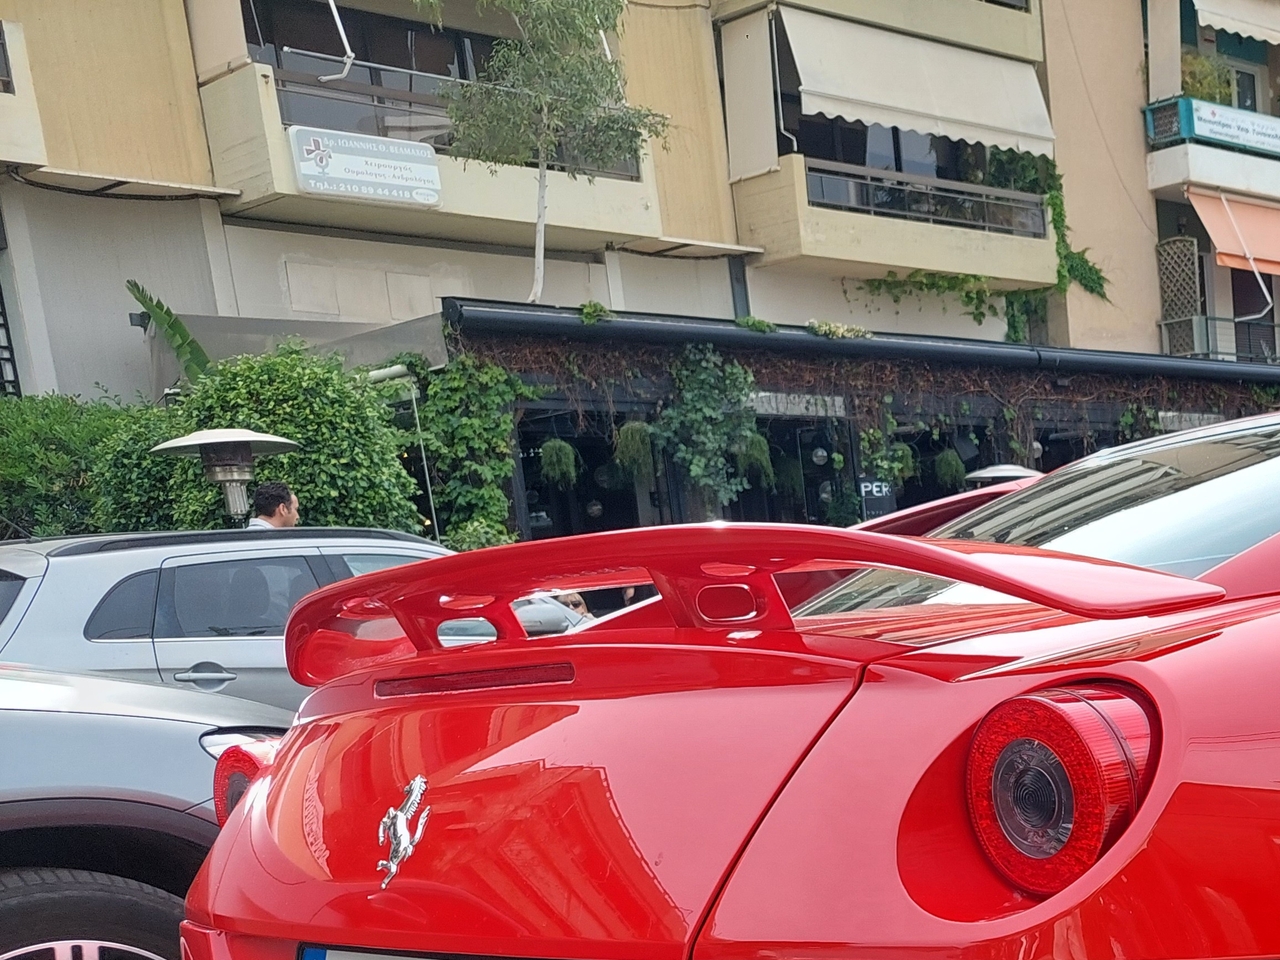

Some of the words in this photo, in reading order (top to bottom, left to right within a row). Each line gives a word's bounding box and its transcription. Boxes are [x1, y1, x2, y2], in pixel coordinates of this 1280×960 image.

[338, 138, 378, 151] ΙΩΑΝΝΗΣ
[339, 183, 359, 192] 210
[361, 185, 374, 194] 89
[377, 187, 389, 196] 44
[391, 188, 411, 199] 418
